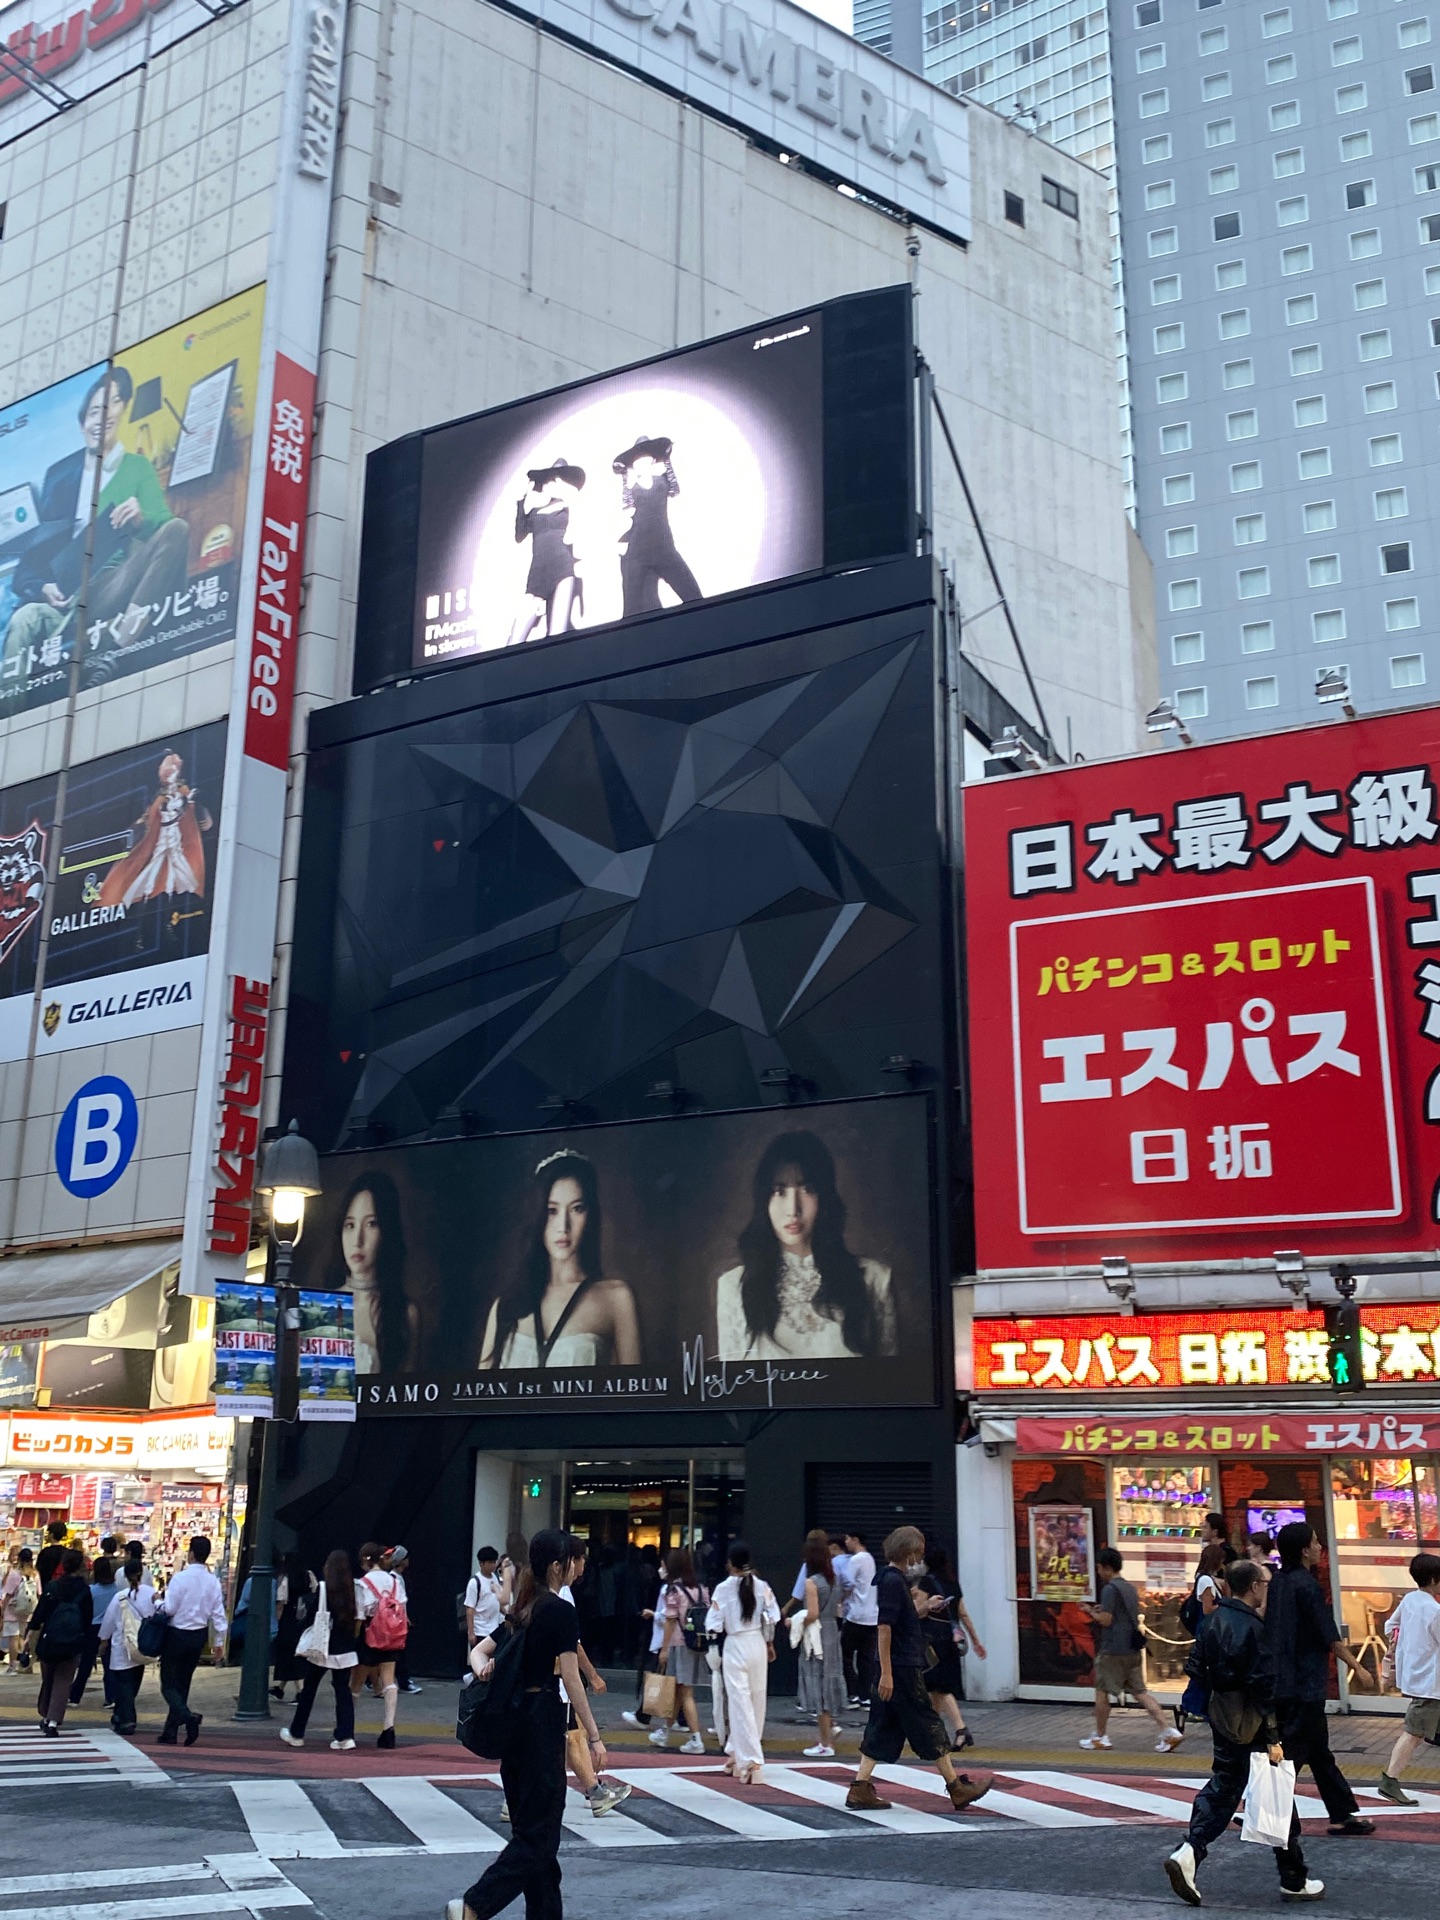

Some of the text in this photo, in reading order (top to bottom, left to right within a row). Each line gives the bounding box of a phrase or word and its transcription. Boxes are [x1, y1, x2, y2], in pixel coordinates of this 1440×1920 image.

[298, 8, 338, 181] CAMERA
[251, 399, 305, 717] 免税 TaxFree
[1010, 767, 1438, 897] 日本最大級
[50, 903, 127, 936] GALLERIA
[1037, 929, 1351, 996] パチンコ&スロット
[67, 981, 192, 1025] GALLERIA
[1040, 997, 1361, 1103] エスパス
[69, 1093, 123, 1182] B
[209, 975, 270, 1256] ビックカメラ
[216, 1331, 276, 1351] LAST BATTLE
[300, 1338, 322, 1355] LAST
[452, 1381, 509, 1397] JAPAN
[519, 1381, 541, 1395] 1st
[552, 1379, 593, 1395] MINI
[603, 1377, 669, 1393] ALBUM
[682, 1334, 829, 1408] Masterpiece
[990, 1324, 1440, 1386] エスパス 日拓 渋本
[12, 1432, 134, 1455] ビックカメラ
[162, 1433, 199, 1451] CAMERA
[1061, 1414, 1428, 1450] パチンコ&スロット エスパス
